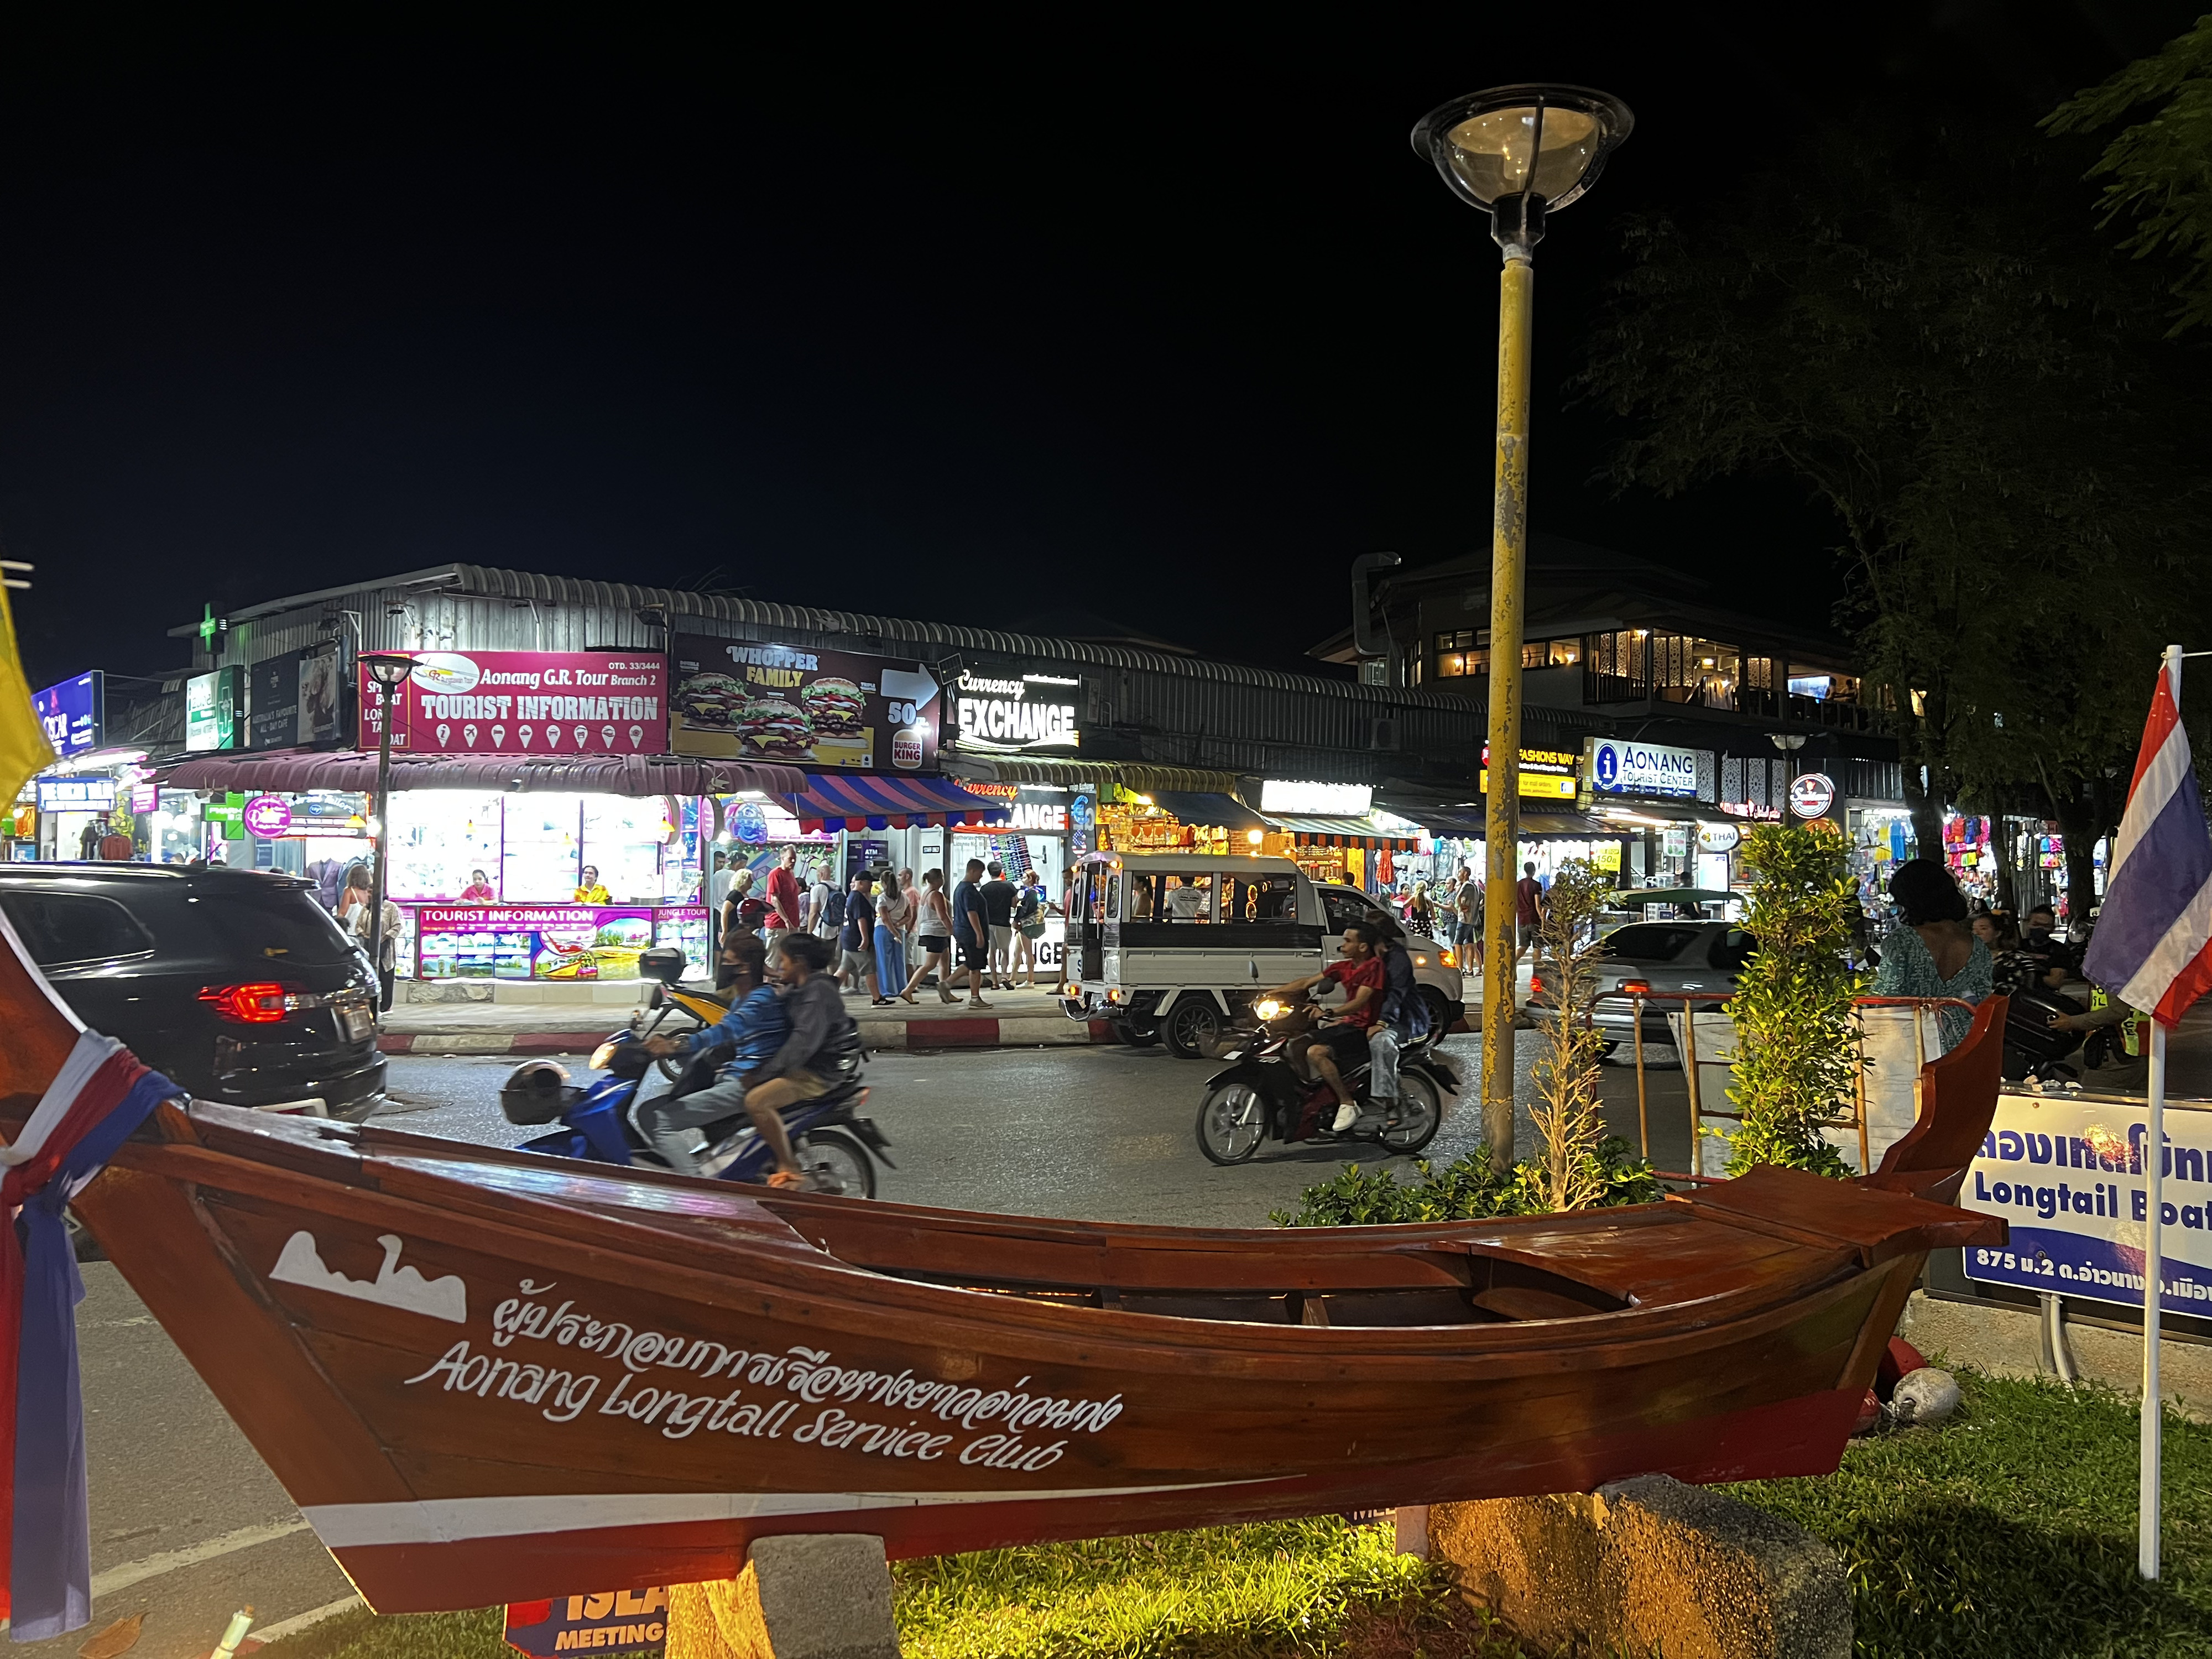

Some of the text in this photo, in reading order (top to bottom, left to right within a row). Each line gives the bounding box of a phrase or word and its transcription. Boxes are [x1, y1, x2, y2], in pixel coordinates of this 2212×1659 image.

[726, 646, 819, 671] WHOPPER
[479, 669, 541, 690] Aonang
[575, 669, 609, 686] Tour
[611, 674, 647, 686] Branch
[649, 674, 656, 686] 2
[747, 666, 804, 688] FAMILY
[958, 669, 1025, 701] Currency
[375, 693, 403, 706] BAT
[421, 695, 658, 720] TOURIST INFORMATION
[888, 701, 916, 725] 50
[958, 697, 1076, 740] EXCHANGE
[894, 741, 921, 750] BURGER
[894, 749, 921, 761] KING
[1519, 748, 1575, 765] ASHIONS WAY
[1623, 746, 1693, 774] AONANG
[1622, 769, 1693, 786] TOURIST CENTER
[1713, 832, 1736, 841] THAI
[423, 910, 593, 921] TOURIST INFORMATION
[1975, 1171, 2119, 1219] Longtail
[1976, 1248, 2016, 1270] 875
[404, 1339, 601, 1423] Aonang
[793, 1407, 954, 1461] Service
[959, 1434, 1070, 1473] Club
[555, 1623, 665, 1651] MEETING
